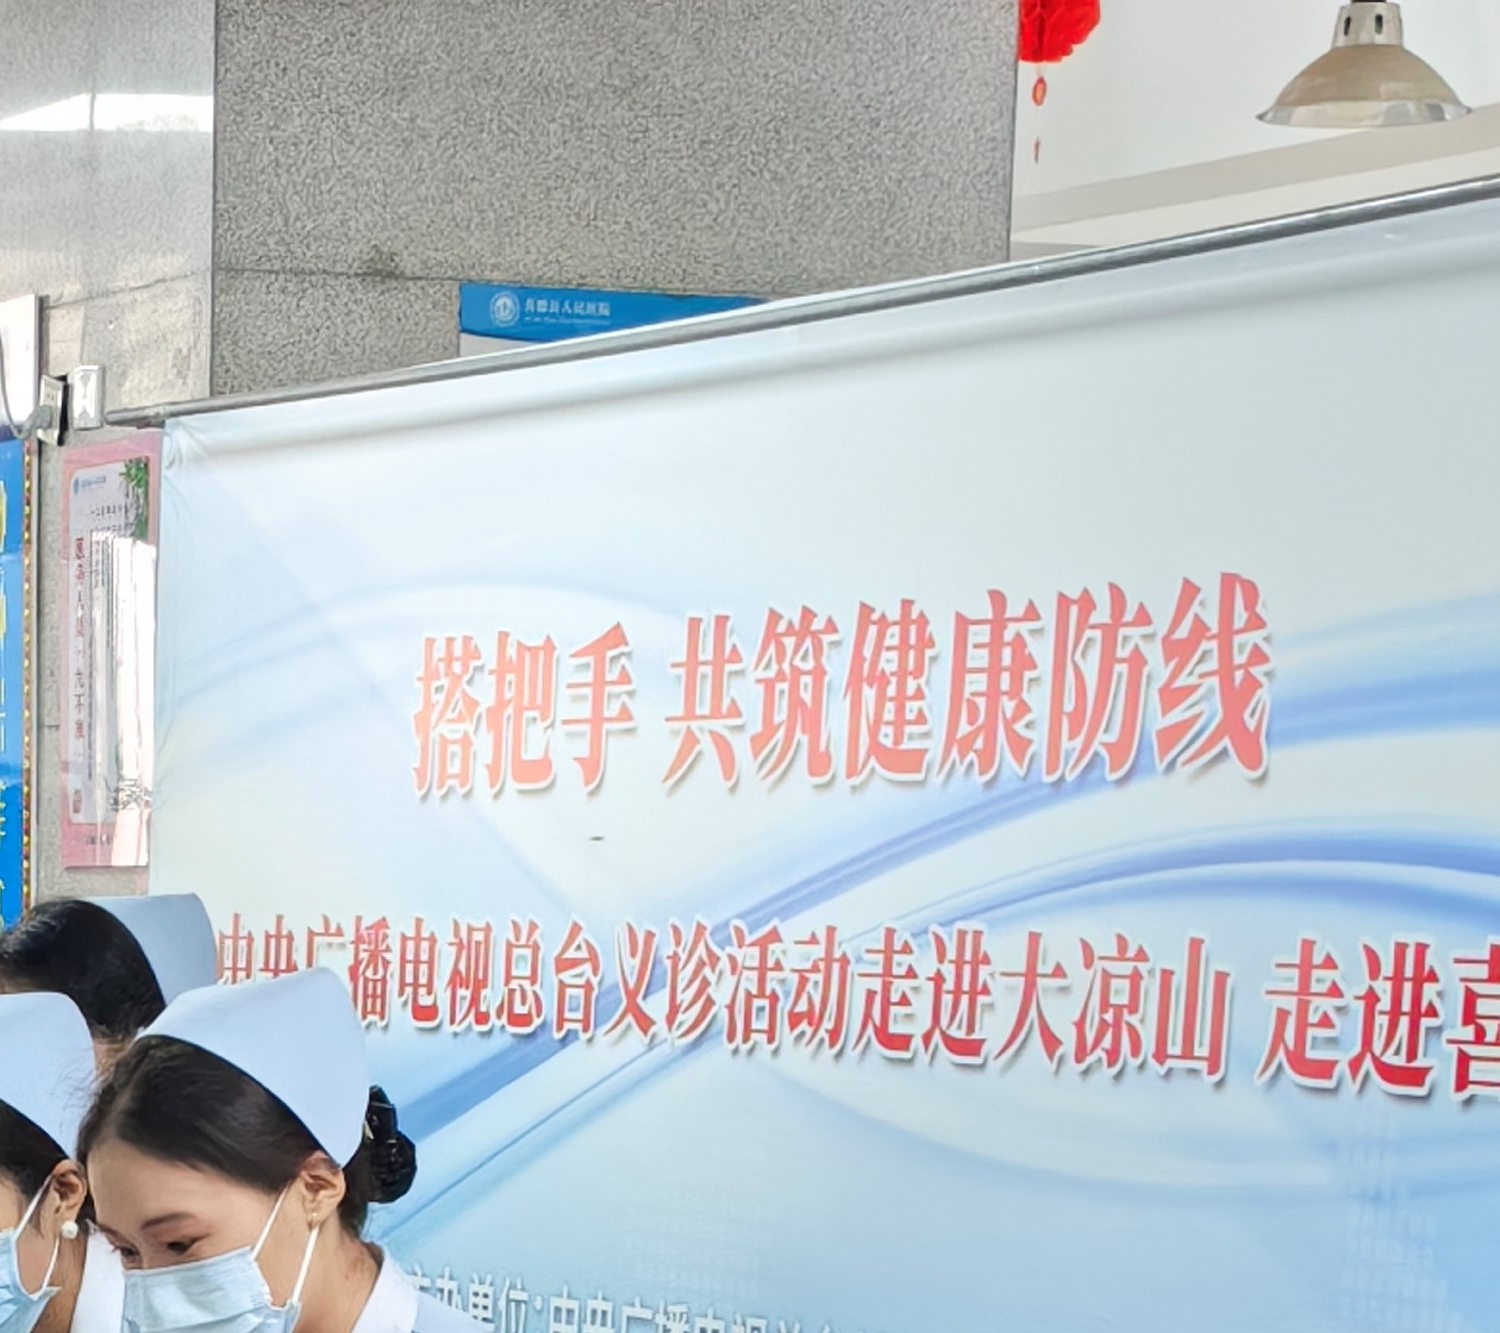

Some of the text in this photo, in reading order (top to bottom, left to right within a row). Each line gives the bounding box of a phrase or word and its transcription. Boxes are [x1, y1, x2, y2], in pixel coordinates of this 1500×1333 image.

[413, 572, 1268, 794] 搭把手 共筑健康防线
